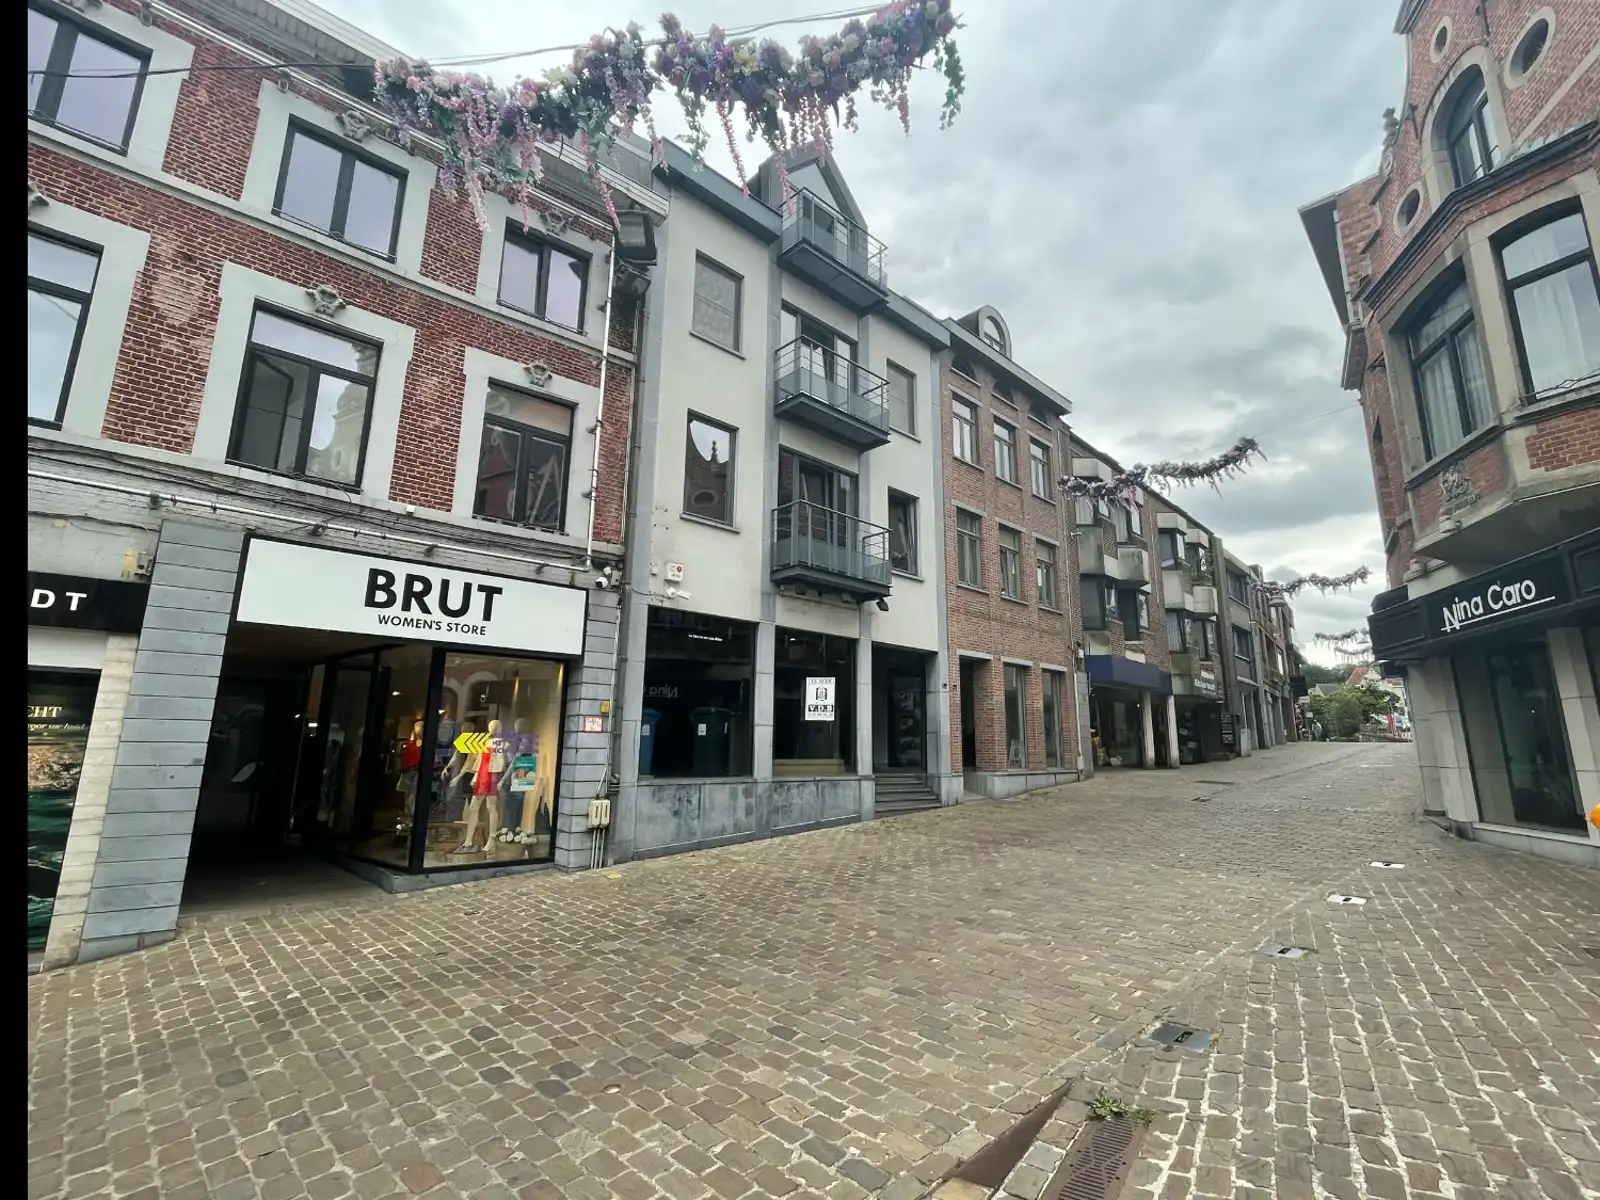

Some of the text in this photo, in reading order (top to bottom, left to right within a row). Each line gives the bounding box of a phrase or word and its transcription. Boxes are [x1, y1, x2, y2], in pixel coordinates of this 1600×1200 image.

[364, 567, 503, 622] BRUT
[1442, 580, 1536, 633] Nina Caro
[378, 614, 486, 636] WOMEN'S STORE
